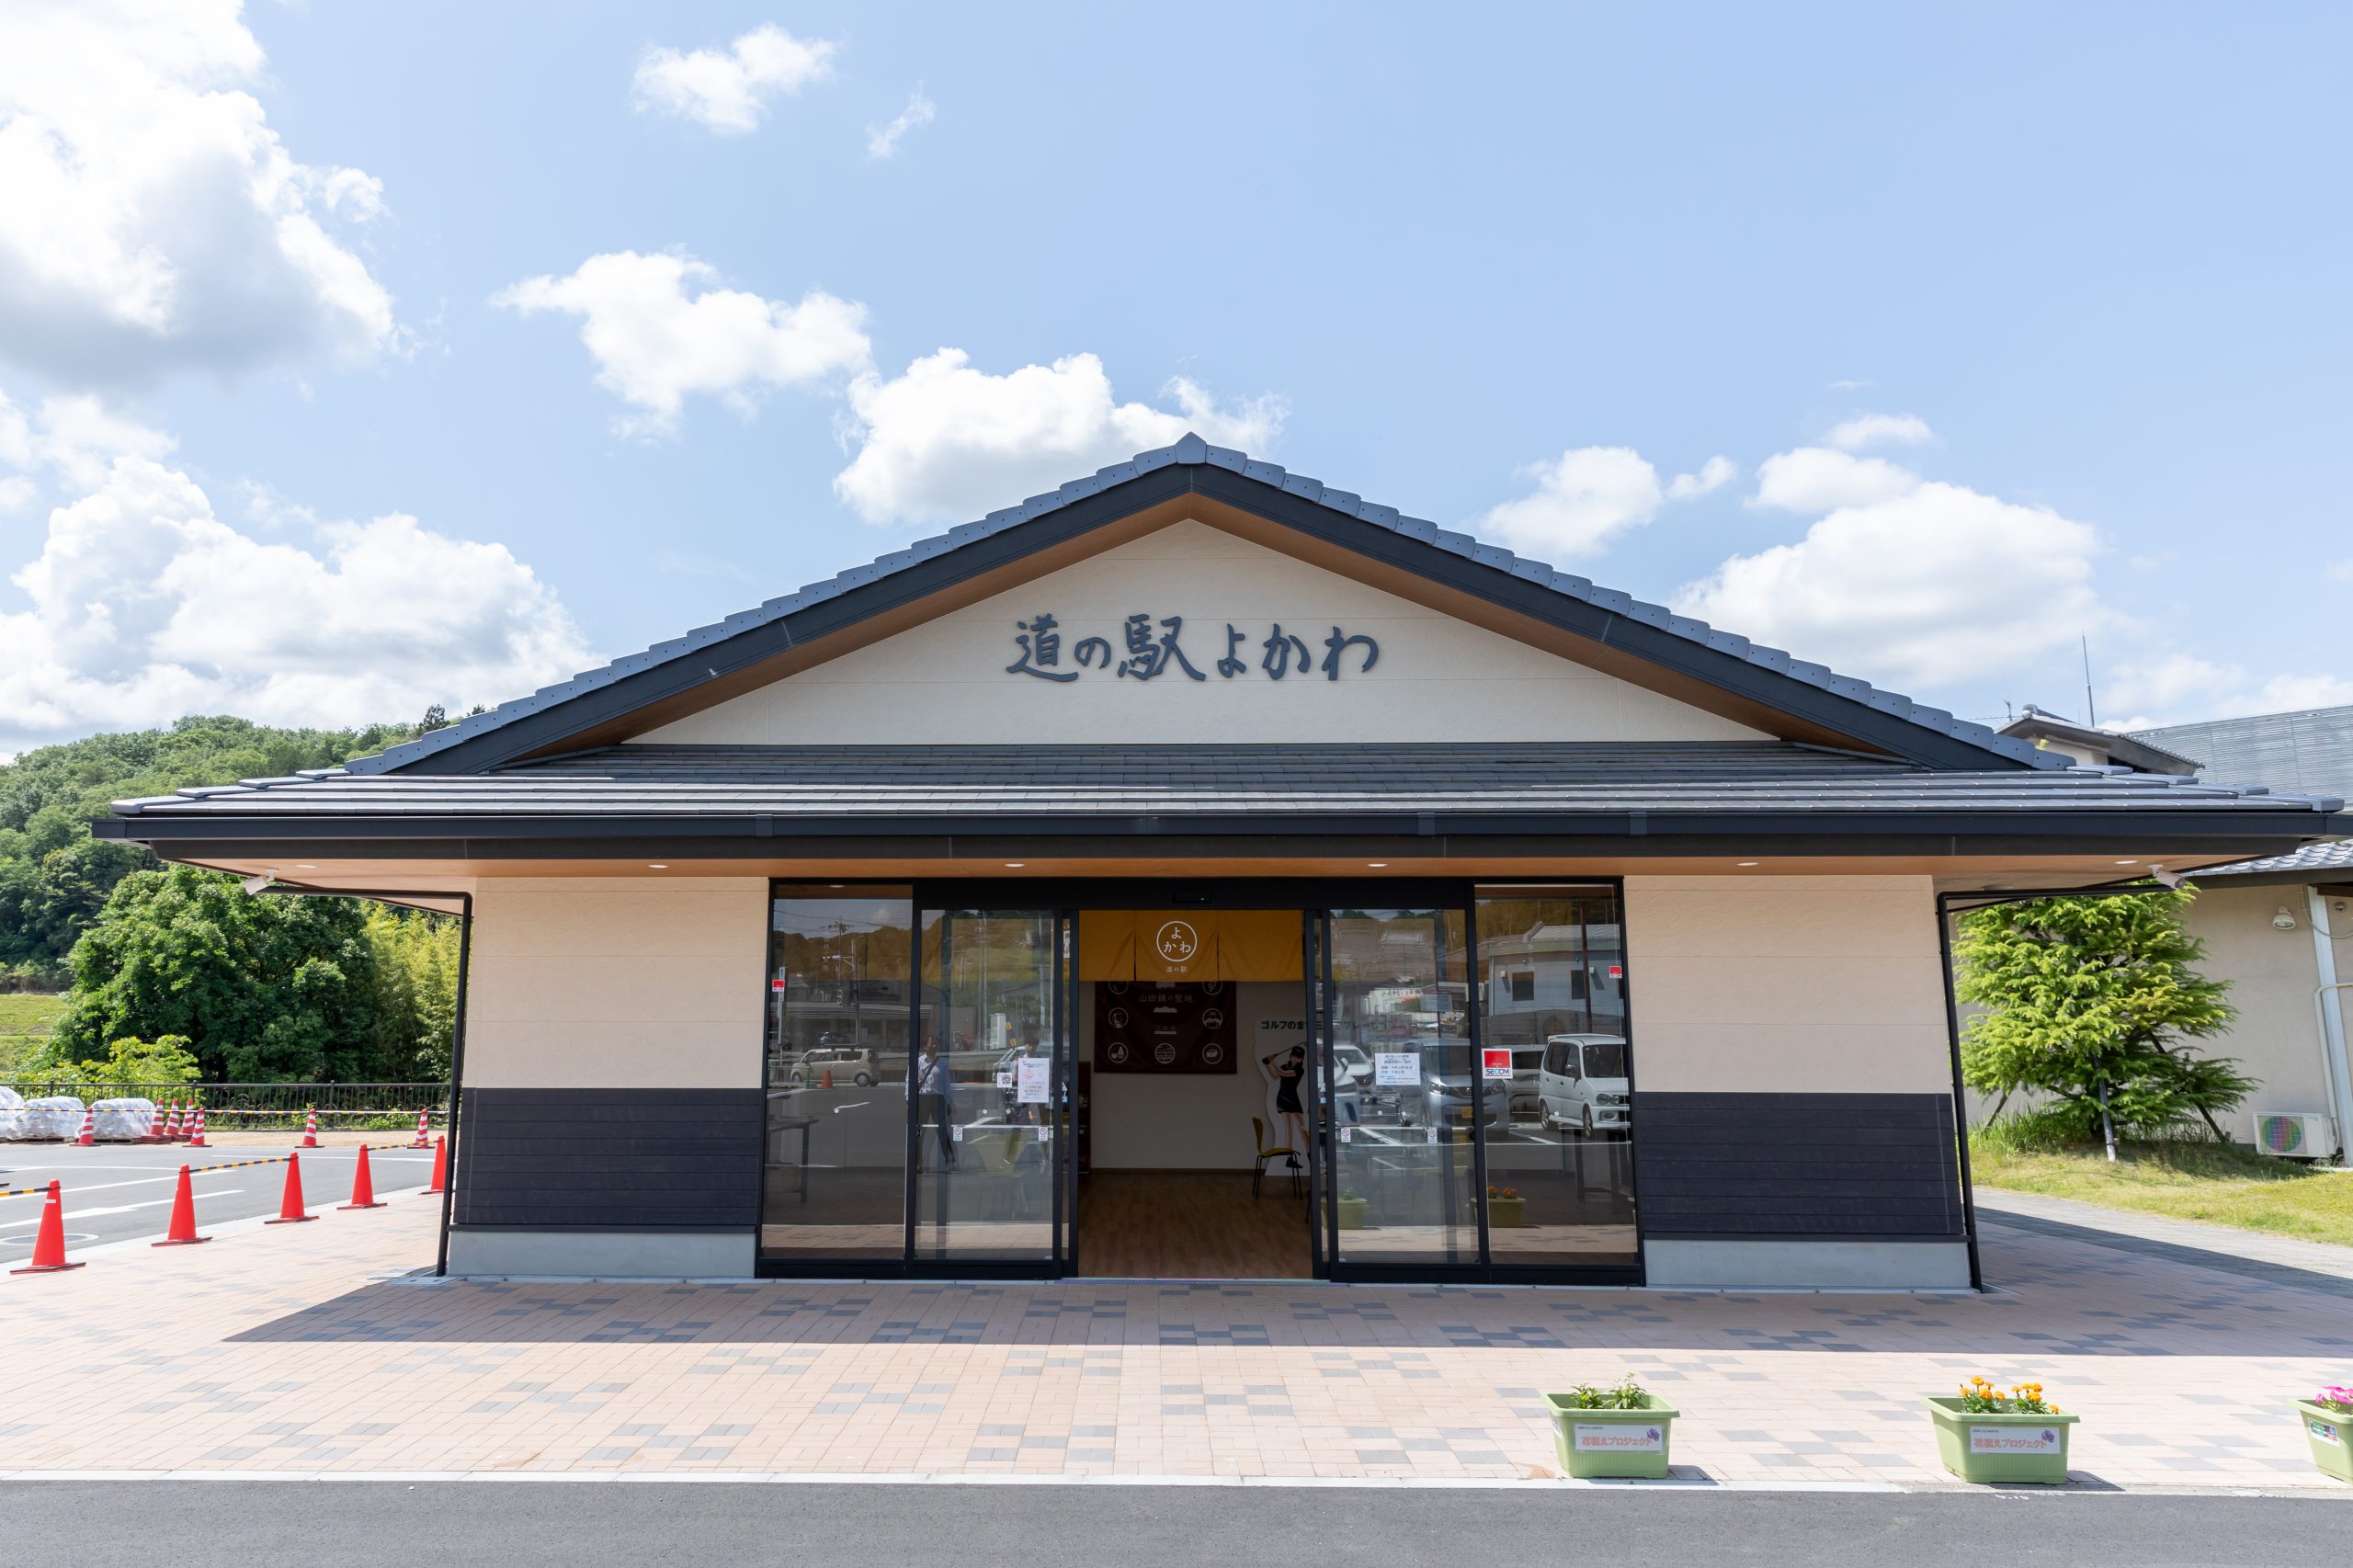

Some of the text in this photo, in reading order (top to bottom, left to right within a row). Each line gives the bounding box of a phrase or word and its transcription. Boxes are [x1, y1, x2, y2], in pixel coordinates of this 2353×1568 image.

[1006, 613, 1381, 682] 道の駅よかわ
[1165, 965, 1188, 973] 道の駅
[1139, 994, 1194, 1004] 山田錦の聖地
[1973, 1437, 2047, 1449] 花植えプロジェクト
